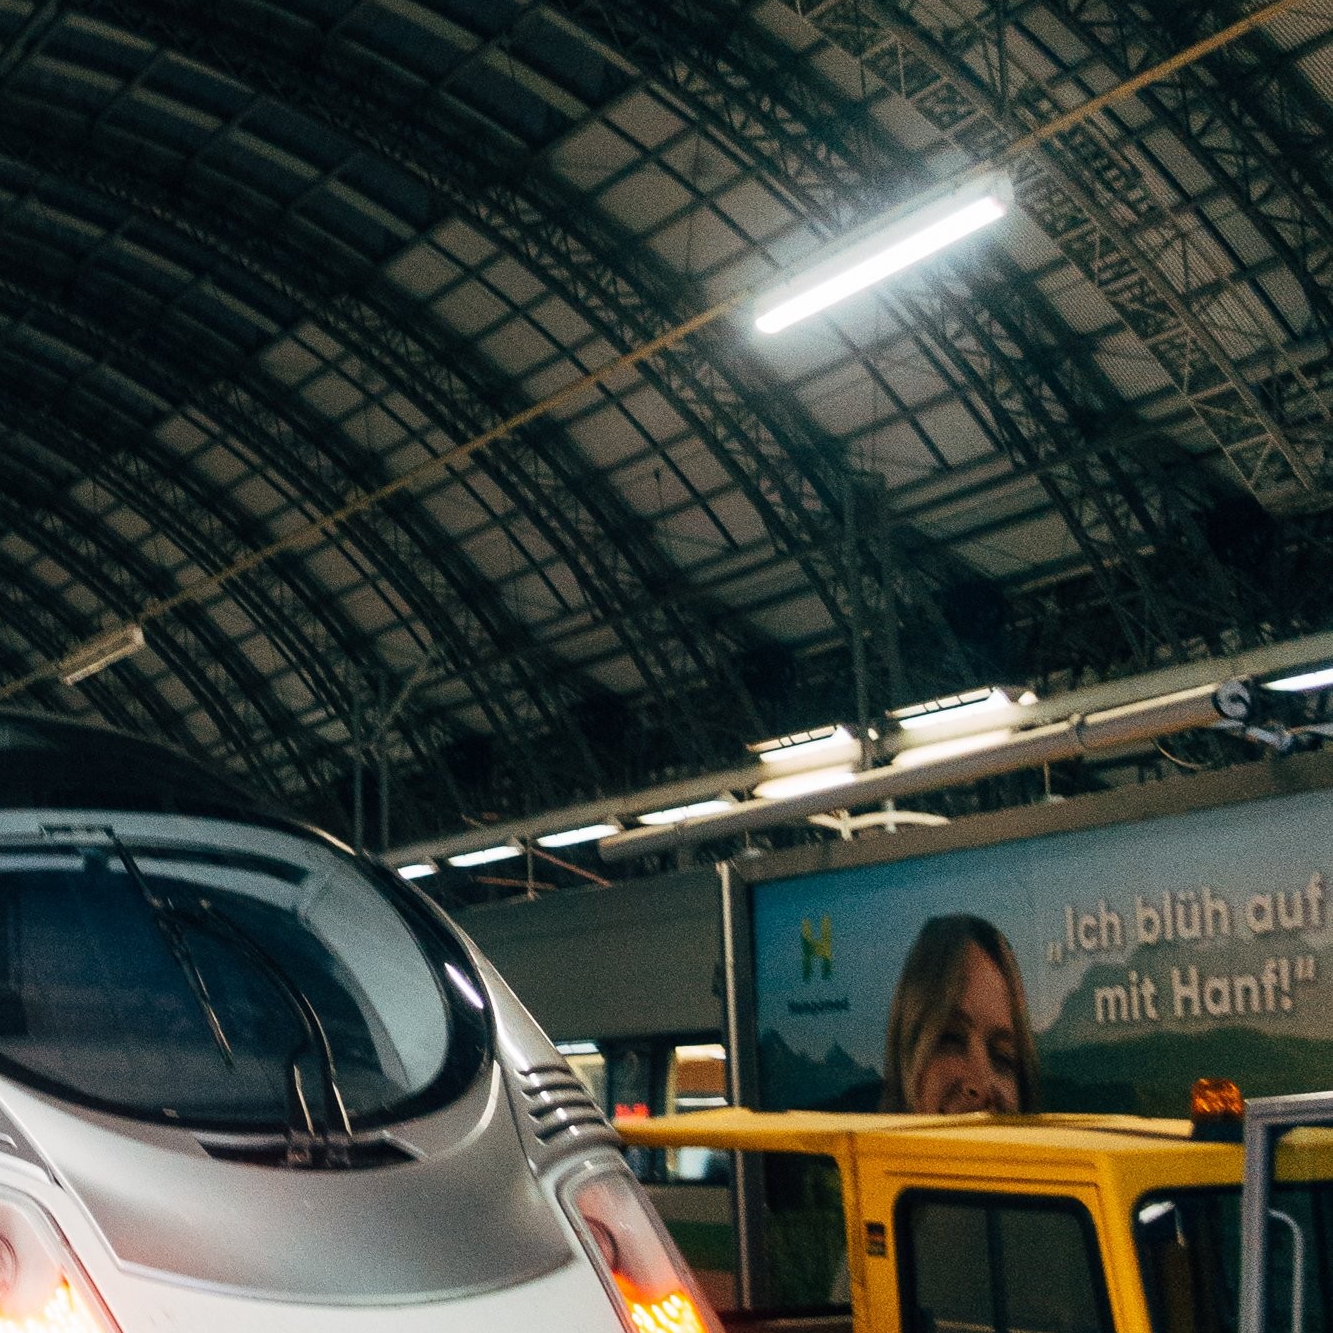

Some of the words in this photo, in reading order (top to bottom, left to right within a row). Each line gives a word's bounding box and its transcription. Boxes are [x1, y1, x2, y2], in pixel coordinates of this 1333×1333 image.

[1133, 886, 1232, 946] blüh
[1245, 871, 1327, 935] auf
[1093, 969, 1159, 1024] mit
